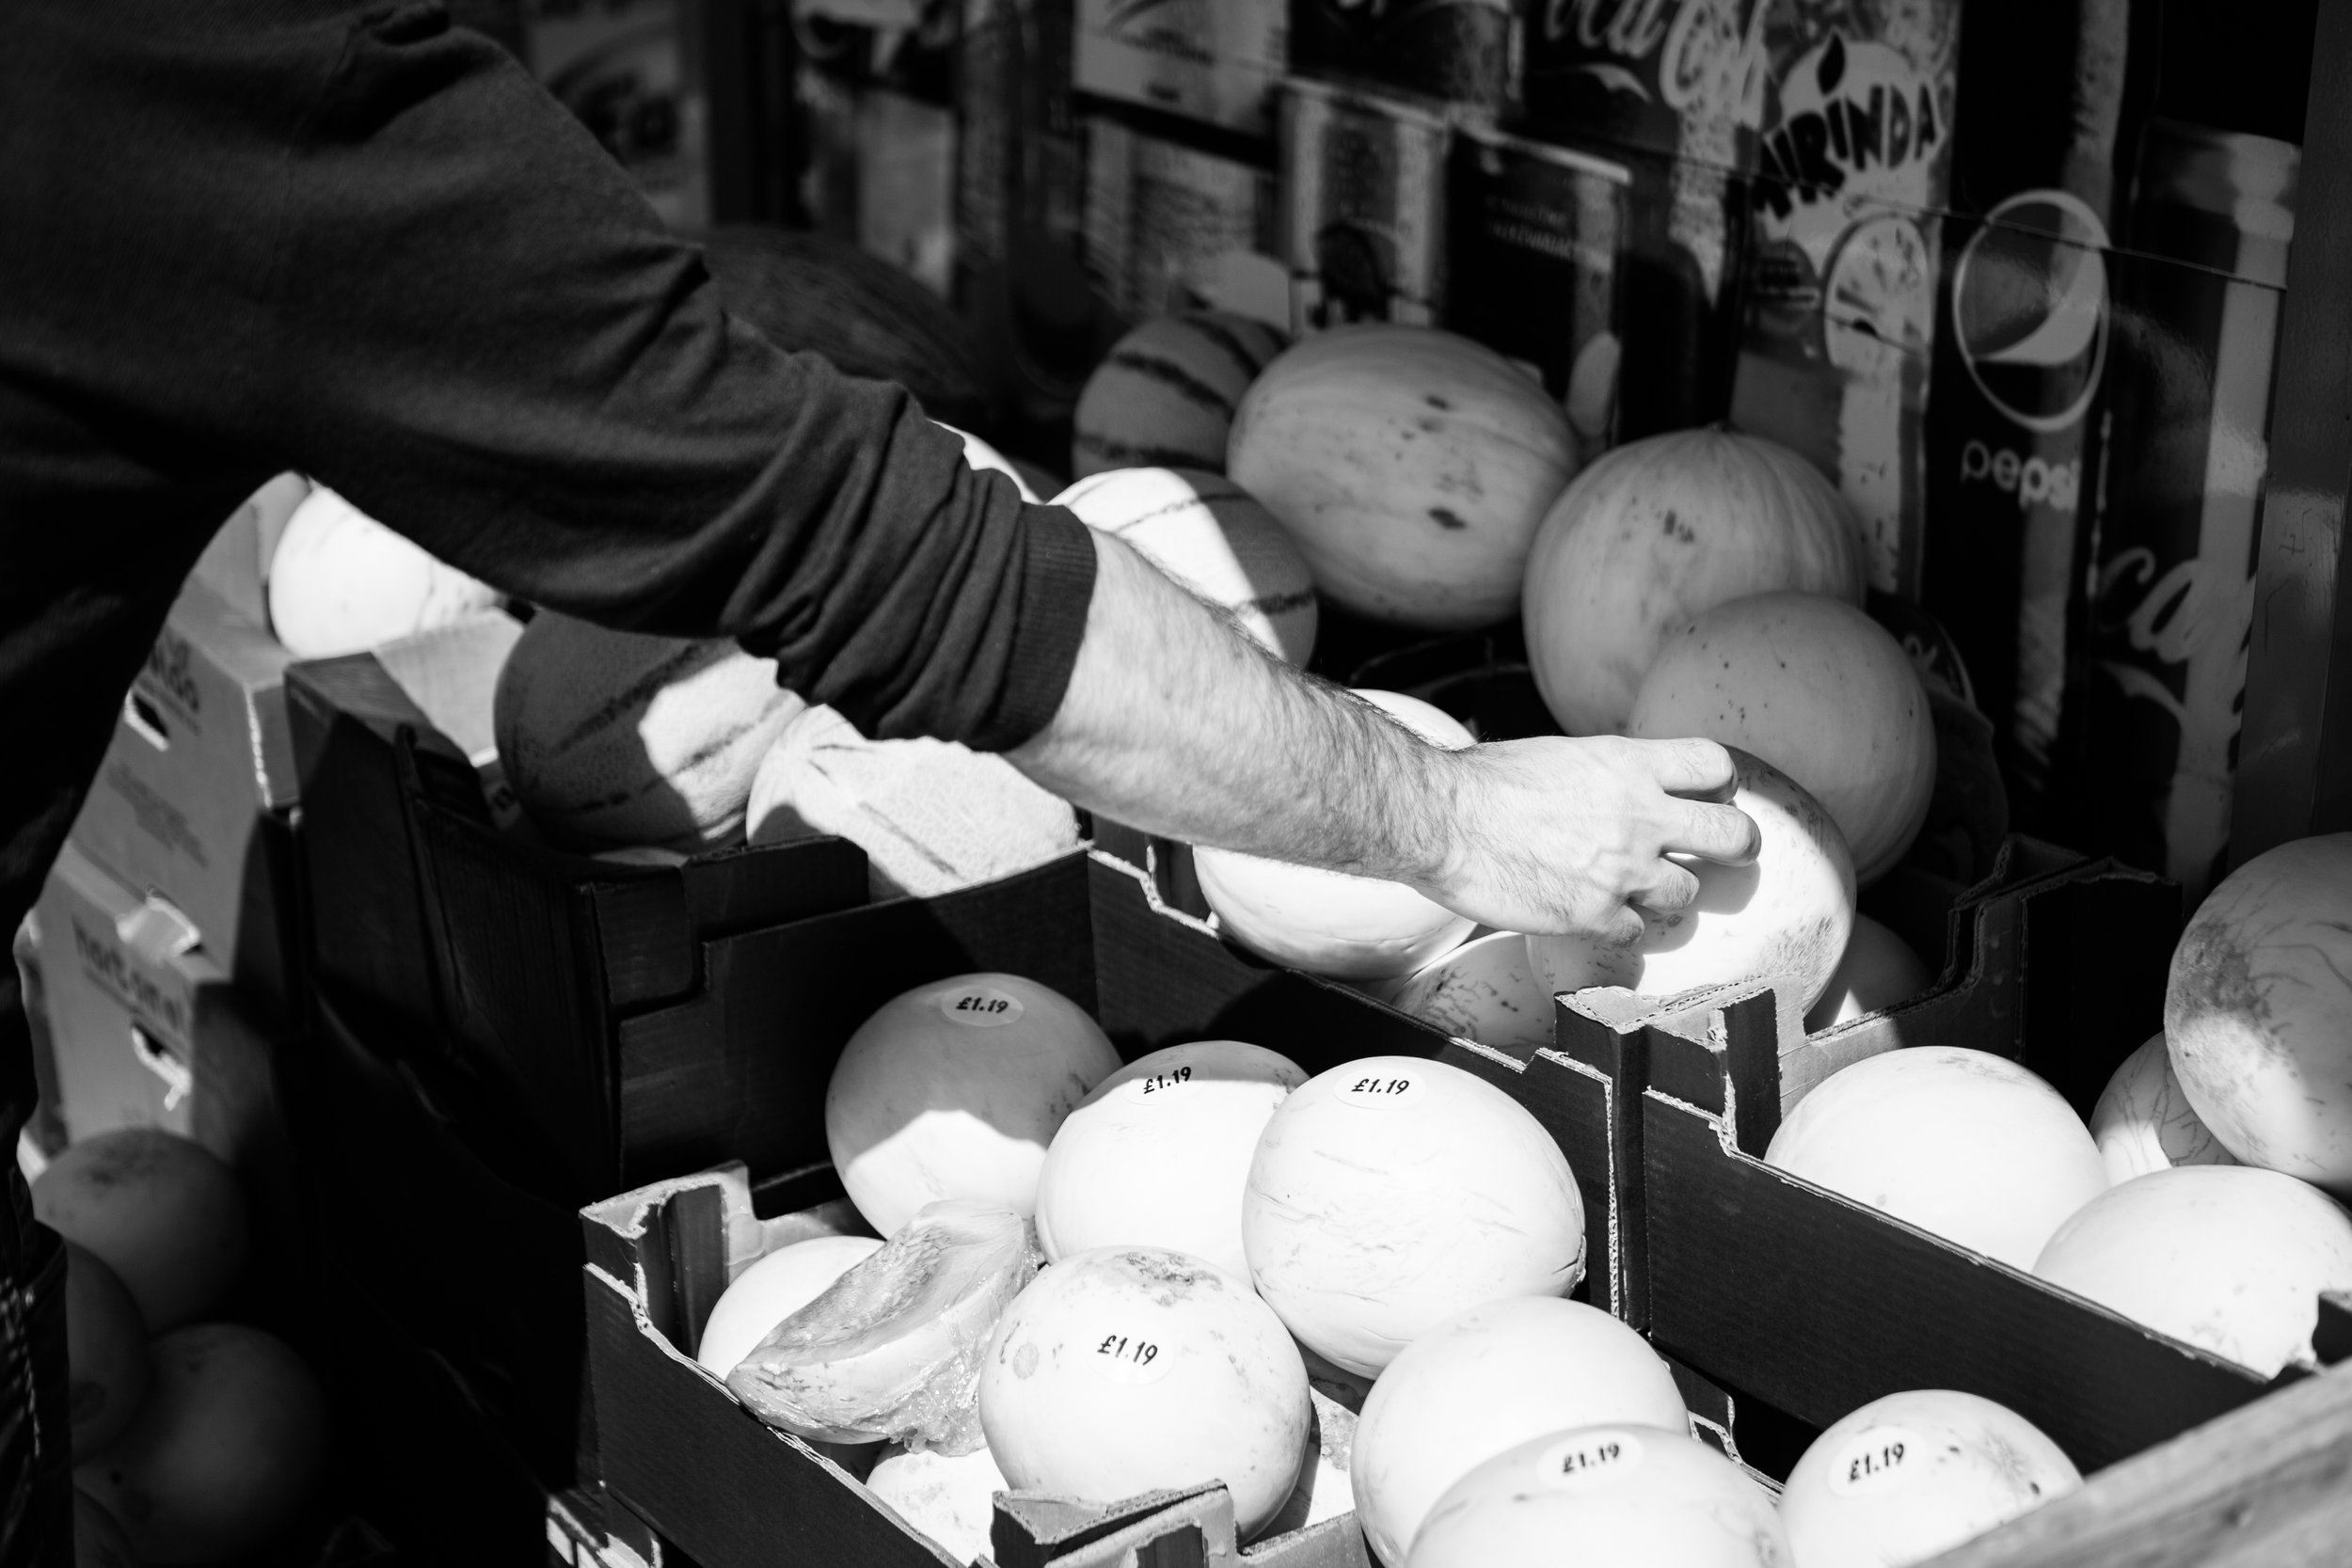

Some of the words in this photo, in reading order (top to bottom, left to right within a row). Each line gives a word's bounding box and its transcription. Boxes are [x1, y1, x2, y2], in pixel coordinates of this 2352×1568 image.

[1959, 437, 2083, 513] pepsi
[955, 995, 1009, 1014] £1.19
[1143, 1066, 1192, 1095] £1.19
[1351, 1078, 1410, 1095] £1.19
[1096, 1334, 1158, 1365] £1.19
[1562, 1441, 1620, 1473] £1.19
[1849, 1442, 1904, 1482] £1.19
